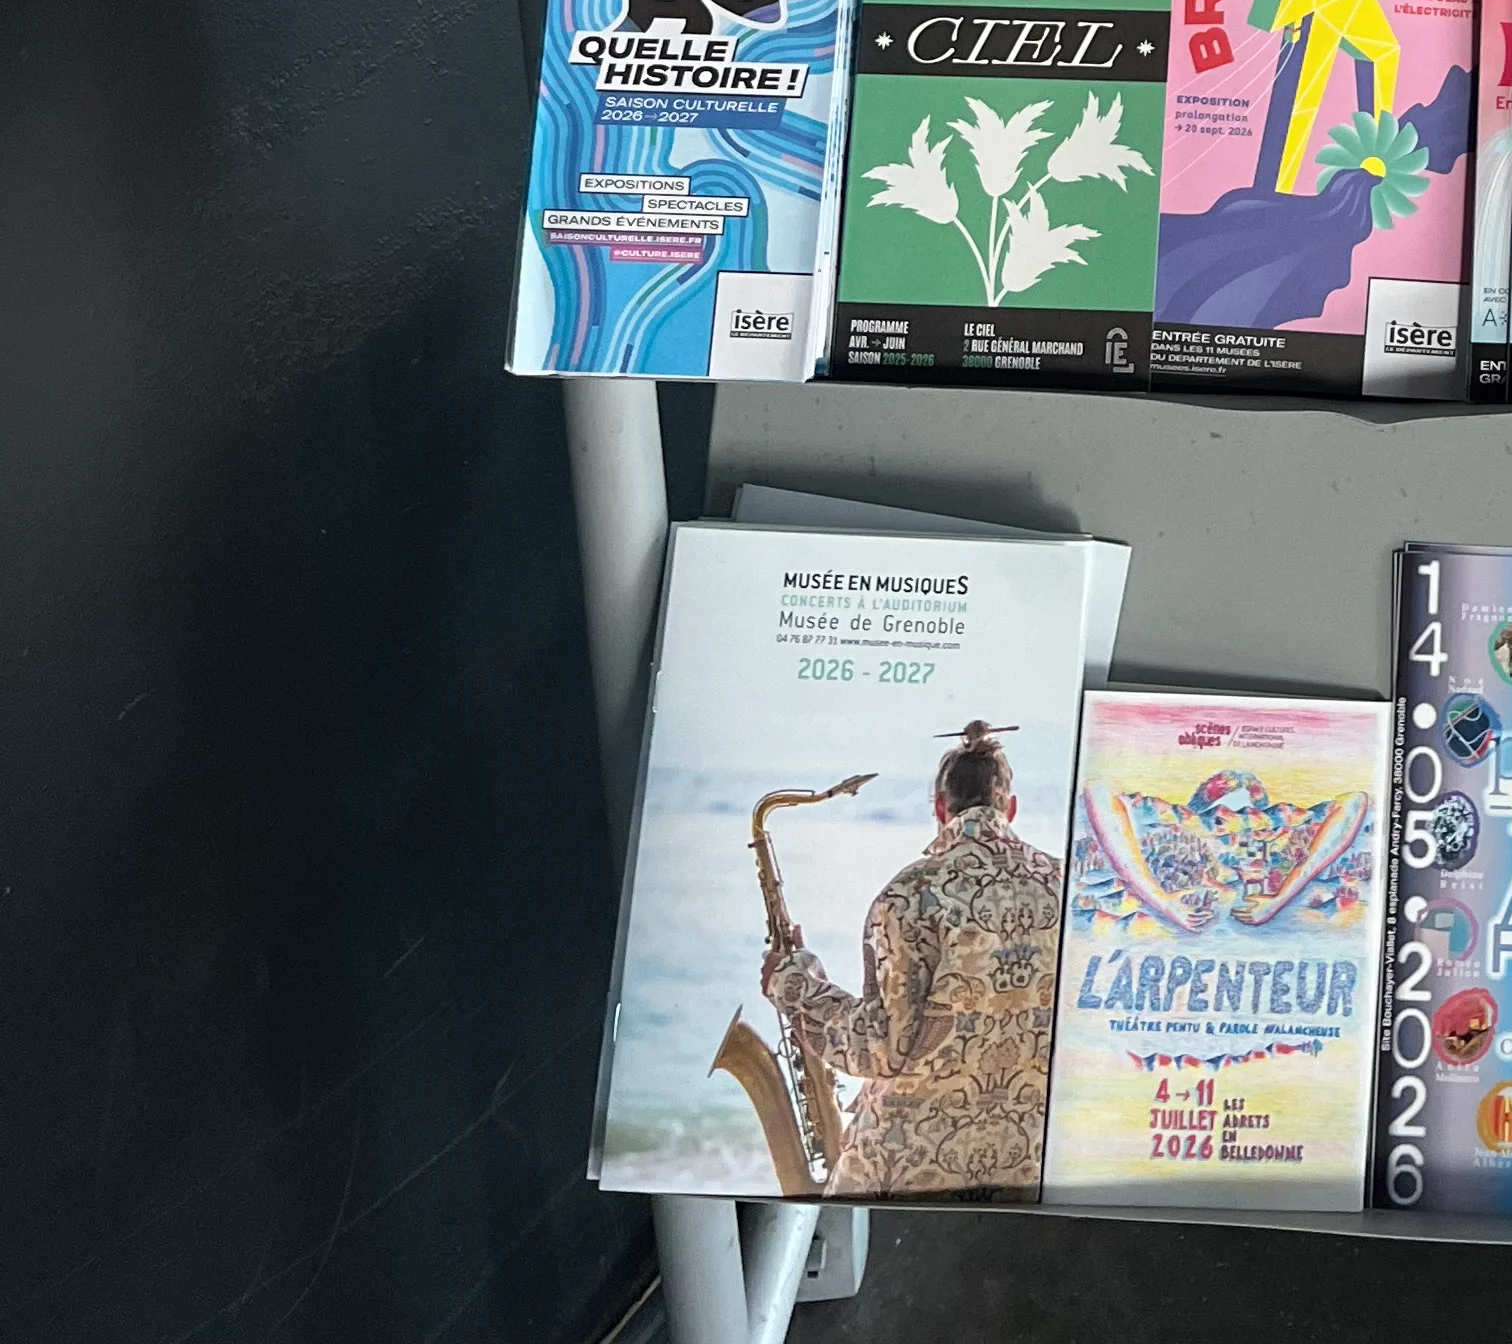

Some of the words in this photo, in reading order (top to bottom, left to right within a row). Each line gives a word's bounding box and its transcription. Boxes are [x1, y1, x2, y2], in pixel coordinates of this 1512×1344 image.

[578, 36, 729, 62] QUELLE
[906, 15, 1124, 68] CIEL
[605, 96, 668, 109] SAISON
[673, 99, 779, 113] CULTURELLE
[584, 178, 685, 191] EXPOSITIONS
[647, 199, 744, 212] SPECTACLES
[548, 214, 611, 227] GRANDS
[616, 215, 719, 231] ÉVÉNEMENTS
[850, 319, 909, 335] PROGRAMME
[971, 340, 988, 353] RUE
[990, 338, 1030, 354] GÉNÉRAL
[1032, 341, 1083, 357] MARCHAND
[1152, 330, 1211, 344] ENTRÉE
[1214, 333, 1286, 348] GRATUITE
[783, 570, 844, 590] MUSÉE
[782, 595, 851, 609] CONCERTS
[873, 598, 968, 613] L'AUDITORIUM
[779, 611, 839, 630] Musée
[850, 614, 872, 631] de
[883, 614, 965, 634] Grenoble
[798, 658, 854, 681] 2026
[879, 661, 935, 684] 2027
[1150, 1108, 1218, 1131] JUILLET
[1151, 1133, 1214, 1161] 2026
[1219, 1145, 1304, 1162] BELLEDONNE
